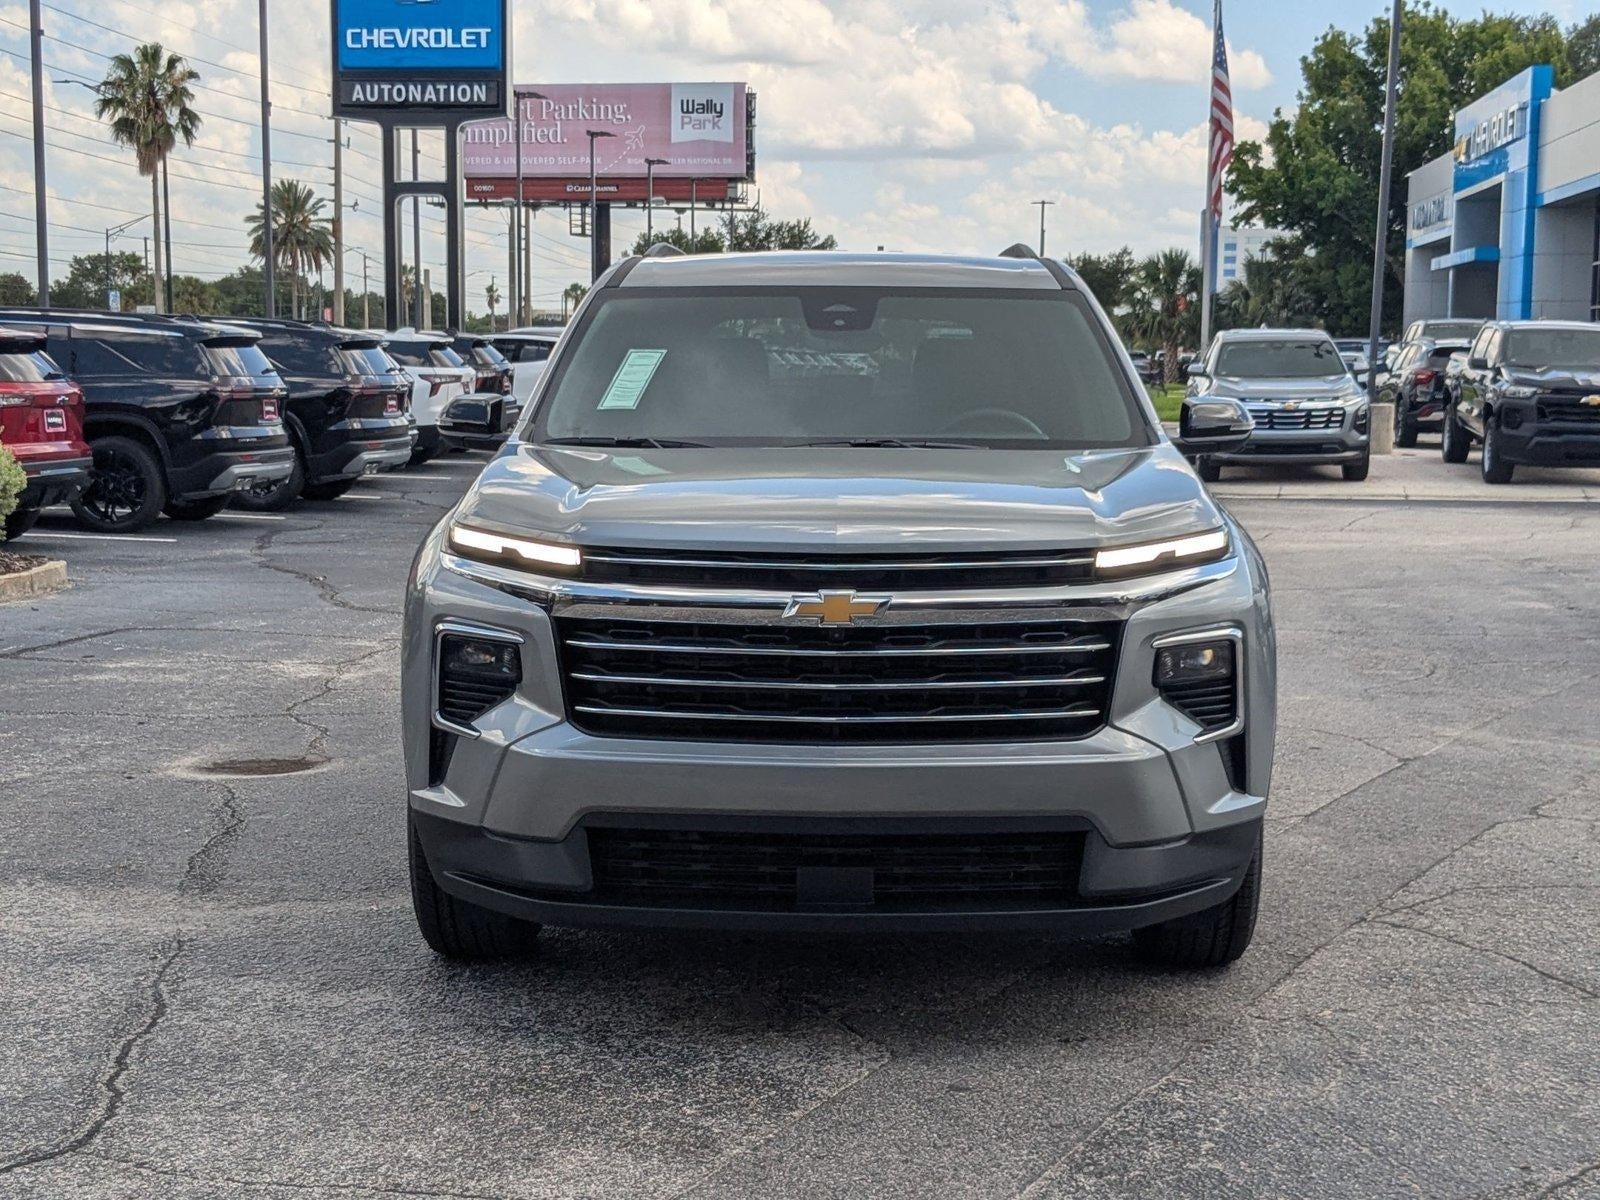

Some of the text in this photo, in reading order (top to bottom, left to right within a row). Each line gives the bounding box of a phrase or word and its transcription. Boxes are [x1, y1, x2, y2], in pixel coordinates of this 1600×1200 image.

[346, 28, 491, 48] CHEVROLET
[352, 83, 487, 102] AUTONATION
[541, 97, 632, 124] Parking,
[680, 99, 724, 118] Wally
[680, 116, 722, 130] Park
[465, 121, 567, 147] implfied.
[465, 156, 601, 165] VERED & UNOVERED SELF-PAK
